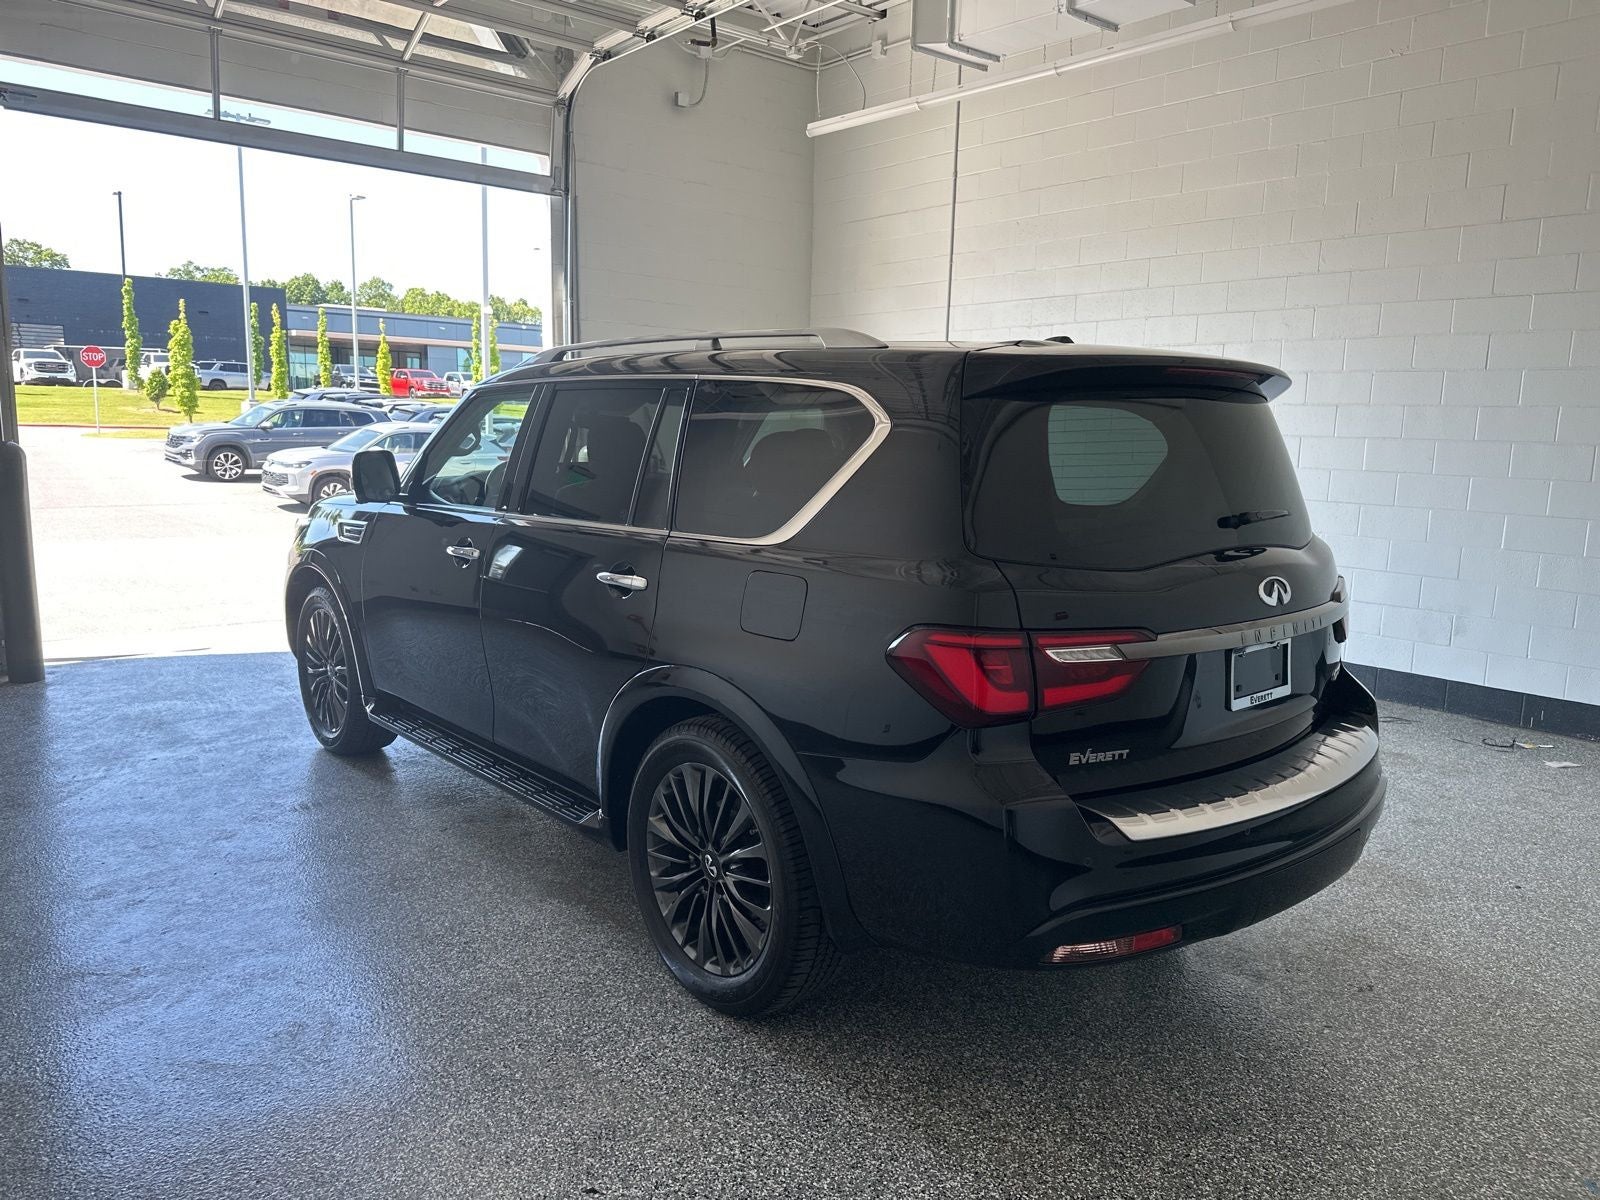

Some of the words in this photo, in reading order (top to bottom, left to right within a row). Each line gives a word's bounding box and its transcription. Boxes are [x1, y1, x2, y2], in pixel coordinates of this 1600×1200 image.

[82, 352, 104, 361] STOP
[1240, 616, 1323, 645] INFINITI
[1250, 692, 1273, 705] EVERETT
[1069, 748, 1130, 765] EVERETT
